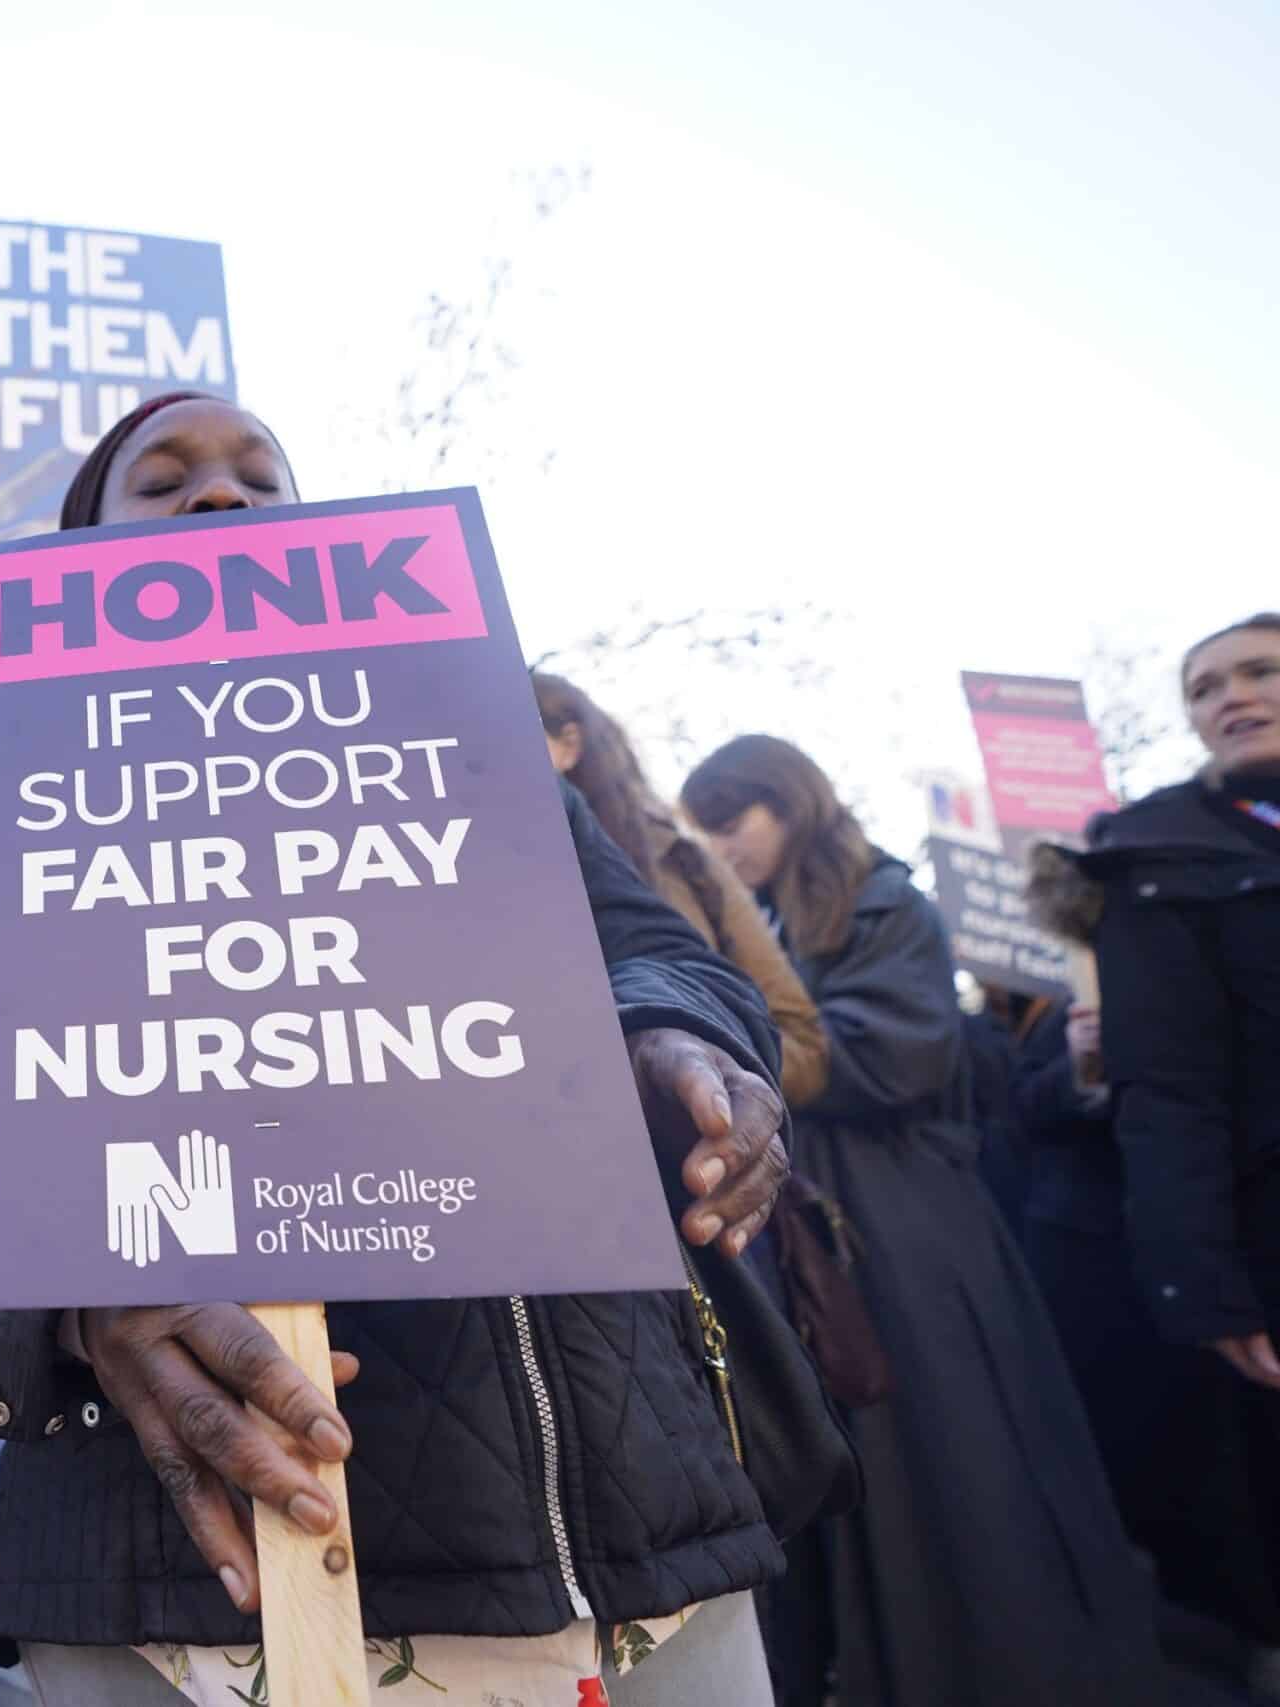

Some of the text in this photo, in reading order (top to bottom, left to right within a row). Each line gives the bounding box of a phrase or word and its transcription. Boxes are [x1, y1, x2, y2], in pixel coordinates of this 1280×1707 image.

[0, 535, 452, 658] HONK
[86, 669, 372, 749] IF YOU
[16, 737, 459, 832] SUPPORT
[22, 818, 472, 915] FAIR PAY
[145, 916, 367, 996] FOR
[15, 1000, 525, 1100] NURSING
[253, 1169, 477, 1219] Royal College
[256, 1217, 435, 1262] of Nursing
